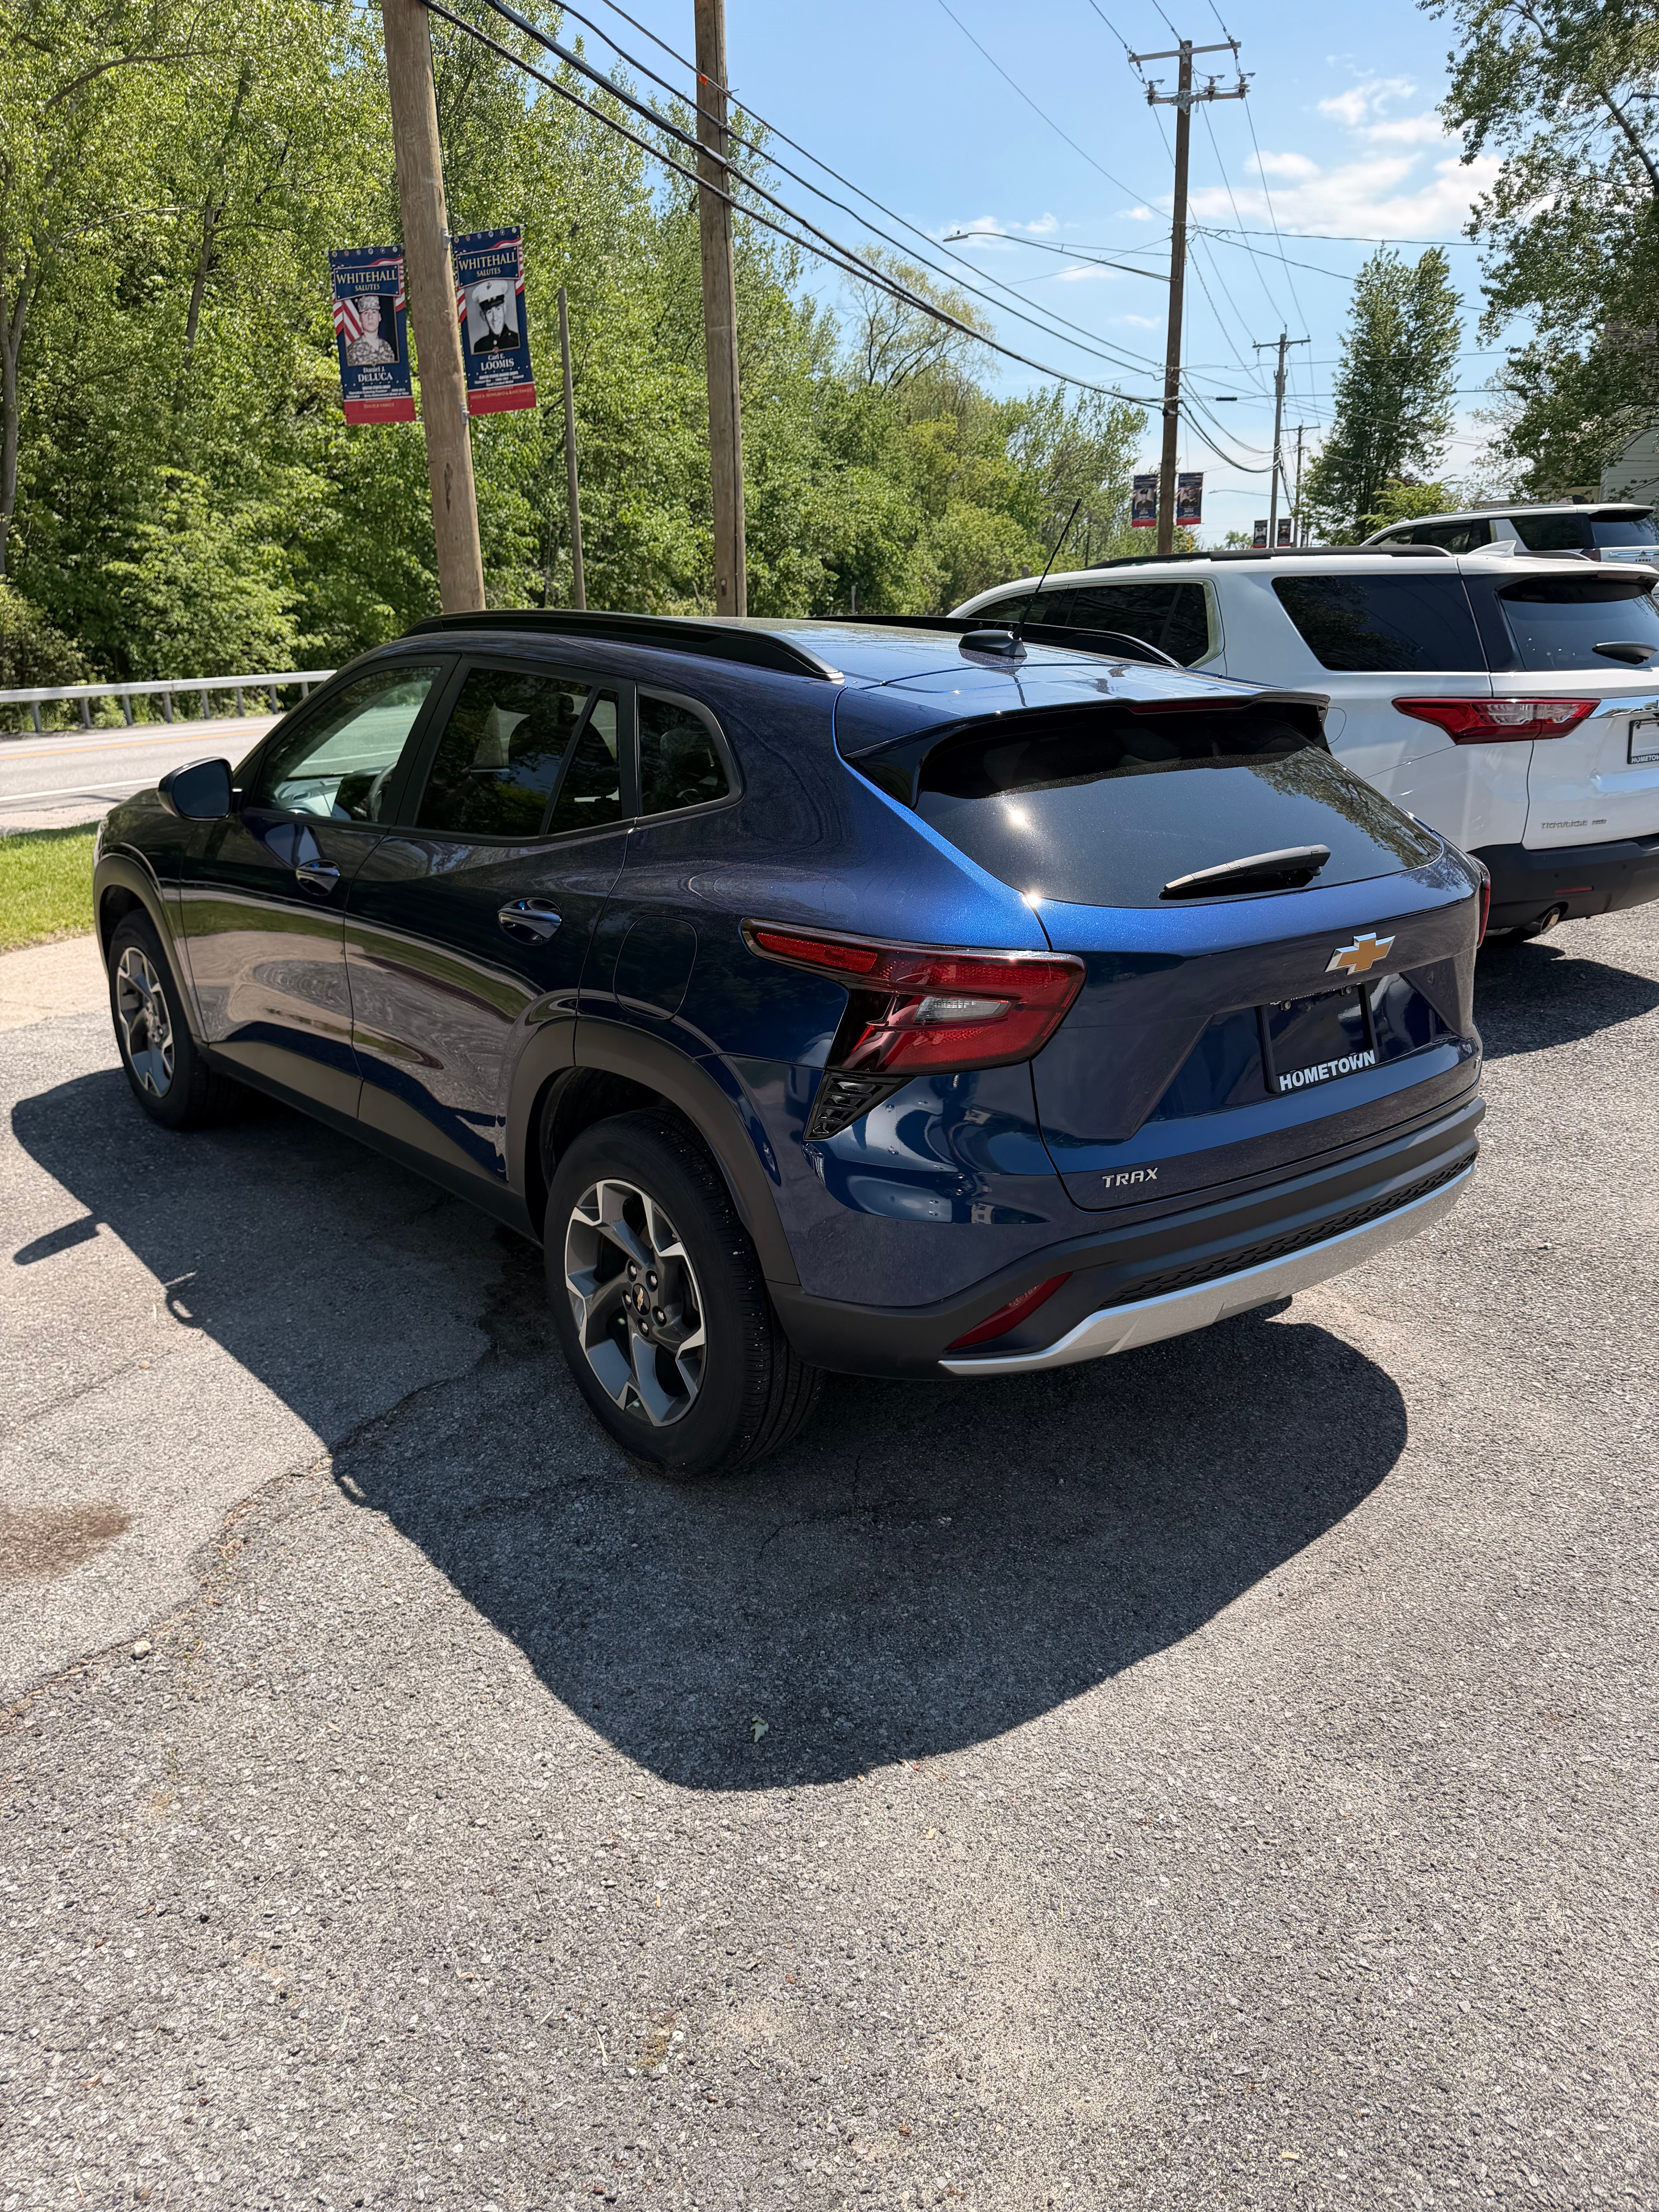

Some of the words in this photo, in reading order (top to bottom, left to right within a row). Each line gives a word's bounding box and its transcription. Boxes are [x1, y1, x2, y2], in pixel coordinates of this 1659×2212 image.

[459, 252, 517, 271] WHITEHALL
[336, 270, 397, 284] WHITEHALL
[476, 267, 501, 277] SALUTES
[481, 358, 514, 371] LOOMIS
[1279, 1050, 1375, 1091] HOMETOWN
[1102, 1168, 1158, 1188] TRAX
